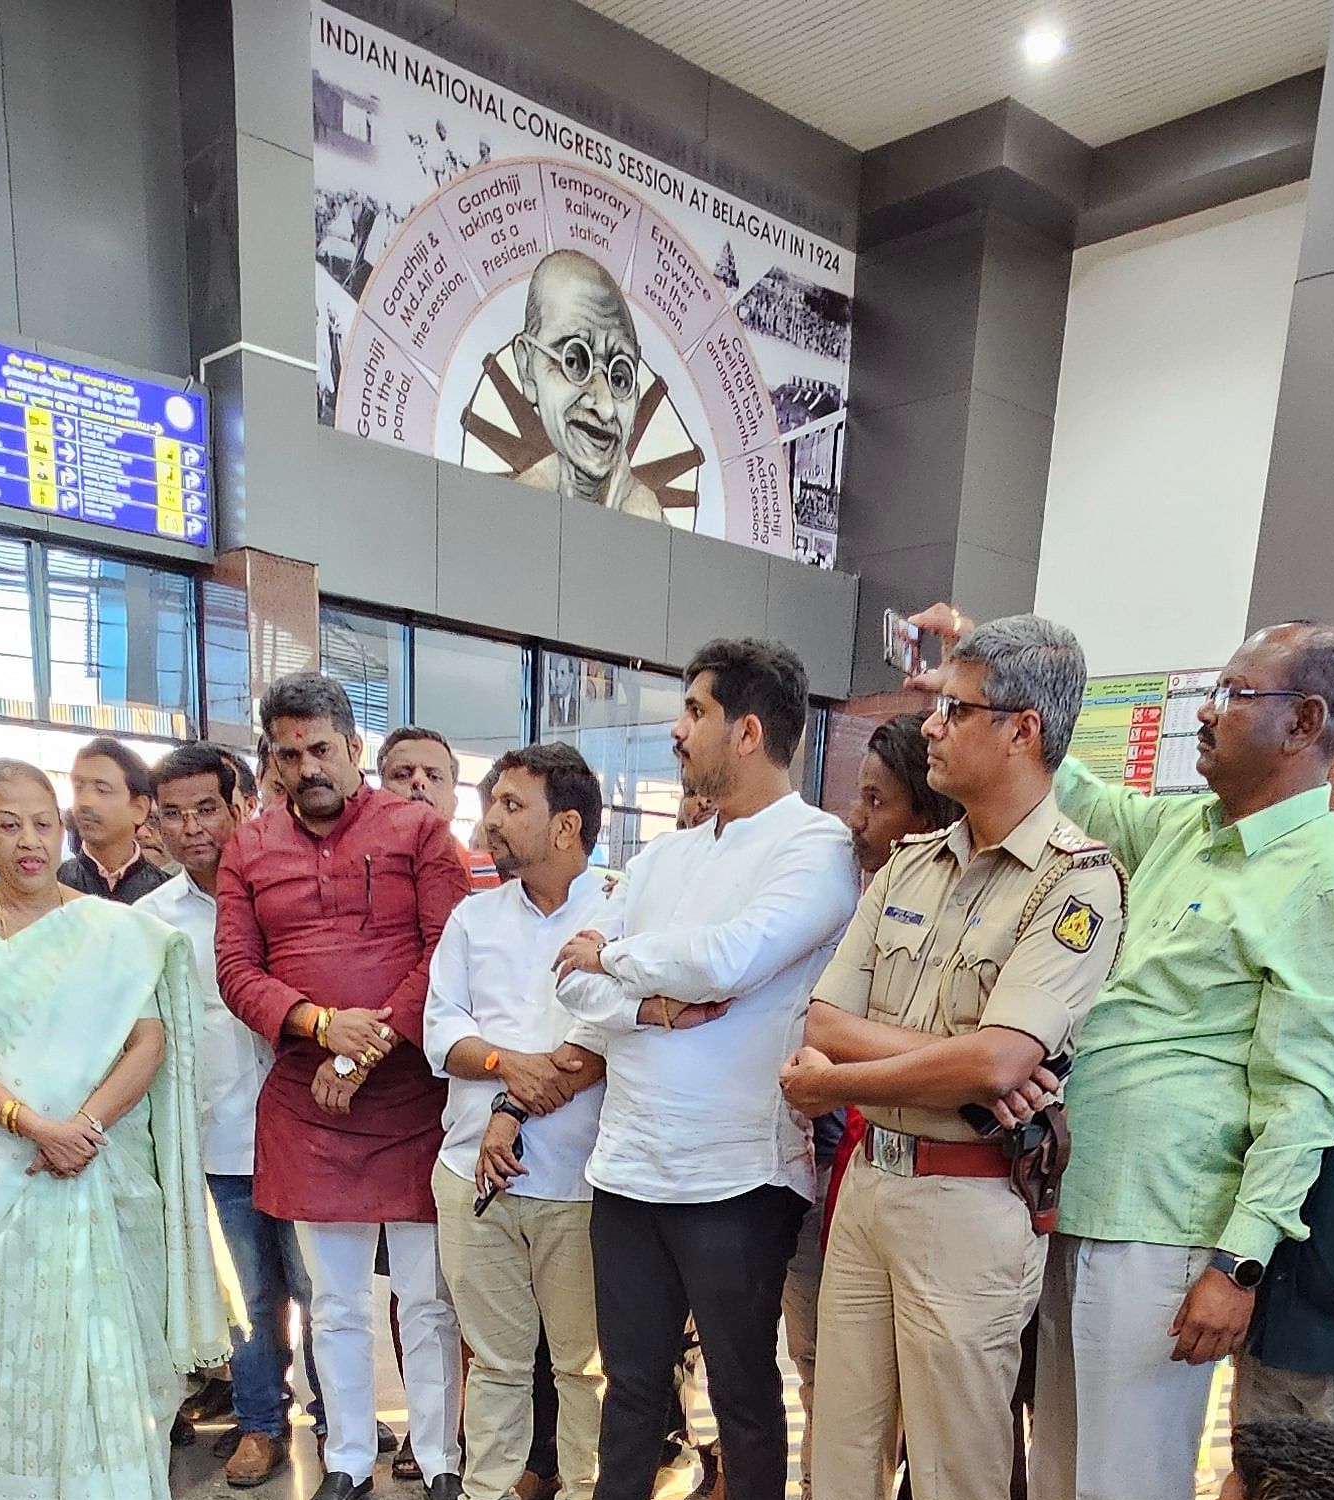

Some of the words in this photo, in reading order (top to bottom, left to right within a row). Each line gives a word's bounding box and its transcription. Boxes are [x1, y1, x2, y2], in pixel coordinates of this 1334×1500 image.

[320, 18, 397, 74] INDIAN
[405, 56, 507, 123] NATIONAL
[513, 105, 612, 169] CONGRESS
[618, 152, 684, 202] SESSION
[689, 188, 708, 213] AT
[713, 198, 786, 251] BELAGAVI
[790, 233, 805, 259] IN
[809, 242, 841, 274] 1924
[457, 174, 521, 214] Gandhiji
[550, 172, 632, 219] Temporary
[565, 198, 618, 234] Railway
[459, 207, 504, 242] taking
[505, 198, 537, 216] over
[491, 228, 507, 245] as
[509, 224, 520, 237] a
[569, 222, 612, 252] station.
[383, 240, 429, 316] Gandhiji
[427, 232, 440, 248] &
[433, 253, 448, 275] at
[481, 236, 542, 277] President.
[650, 225, 712, 302] Entrance
[656, 249, 695, 299] Tower
[411, 321, 430, 349] the
[426, 271, 468, 322] session.
[643, 284, 684, 336] session.
[653, 273, 668, 289] at
[669, 285, 688, 314] the
[357, 337, 385, 439] Gandhiji
[377, 369, 395, 402] the
[706, 341, 749, 451] arrangements.
[718, 332, 738, 371] Well
[733, 370, 746, 394] for
[742, 396, 759, 437] bath
[732, 337, 764, 419] Congress
[375, 404, 388, 428] at
[393, 372, 414, 442] pandal.
[746, 458, 756, 483] the
[755, 455, 770, 545] Addressing
[768, 462, 782, 538] Gandhiji
